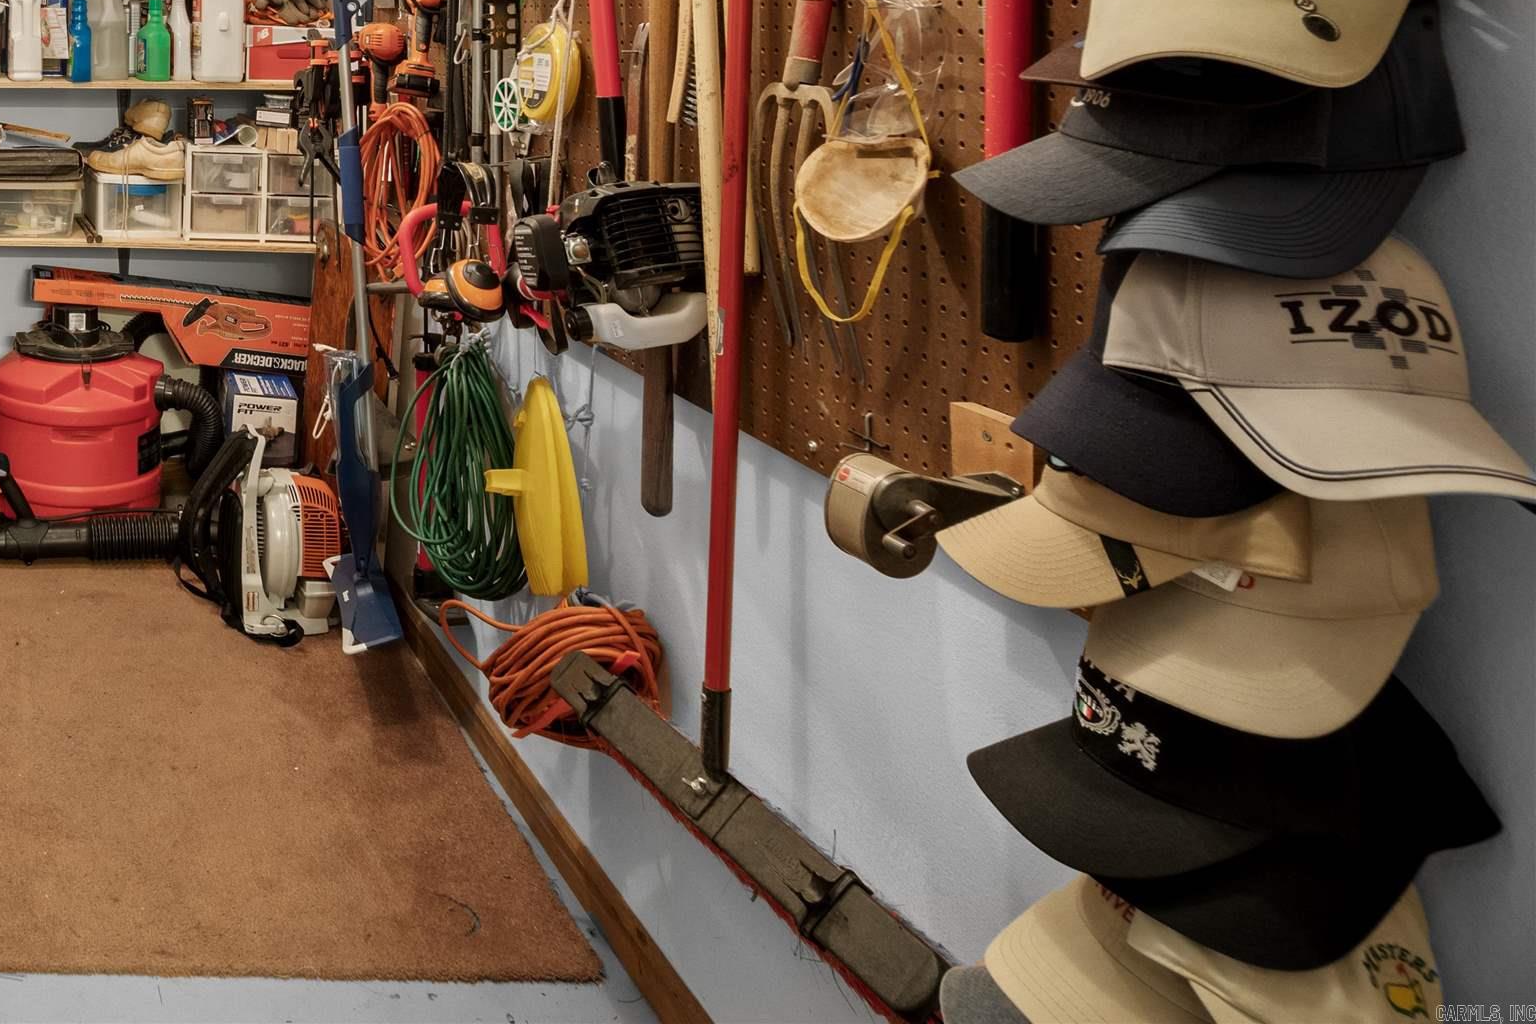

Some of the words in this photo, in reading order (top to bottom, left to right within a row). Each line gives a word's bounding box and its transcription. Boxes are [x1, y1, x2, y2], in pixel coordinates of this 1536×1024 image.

[1280, 299, 1452, 343] IZOD
[233, 351, 308, 371] LACK&DECKER
[239, 403, 282, 411] POWER
[1363, 943, 1441, 989] MASTERS
